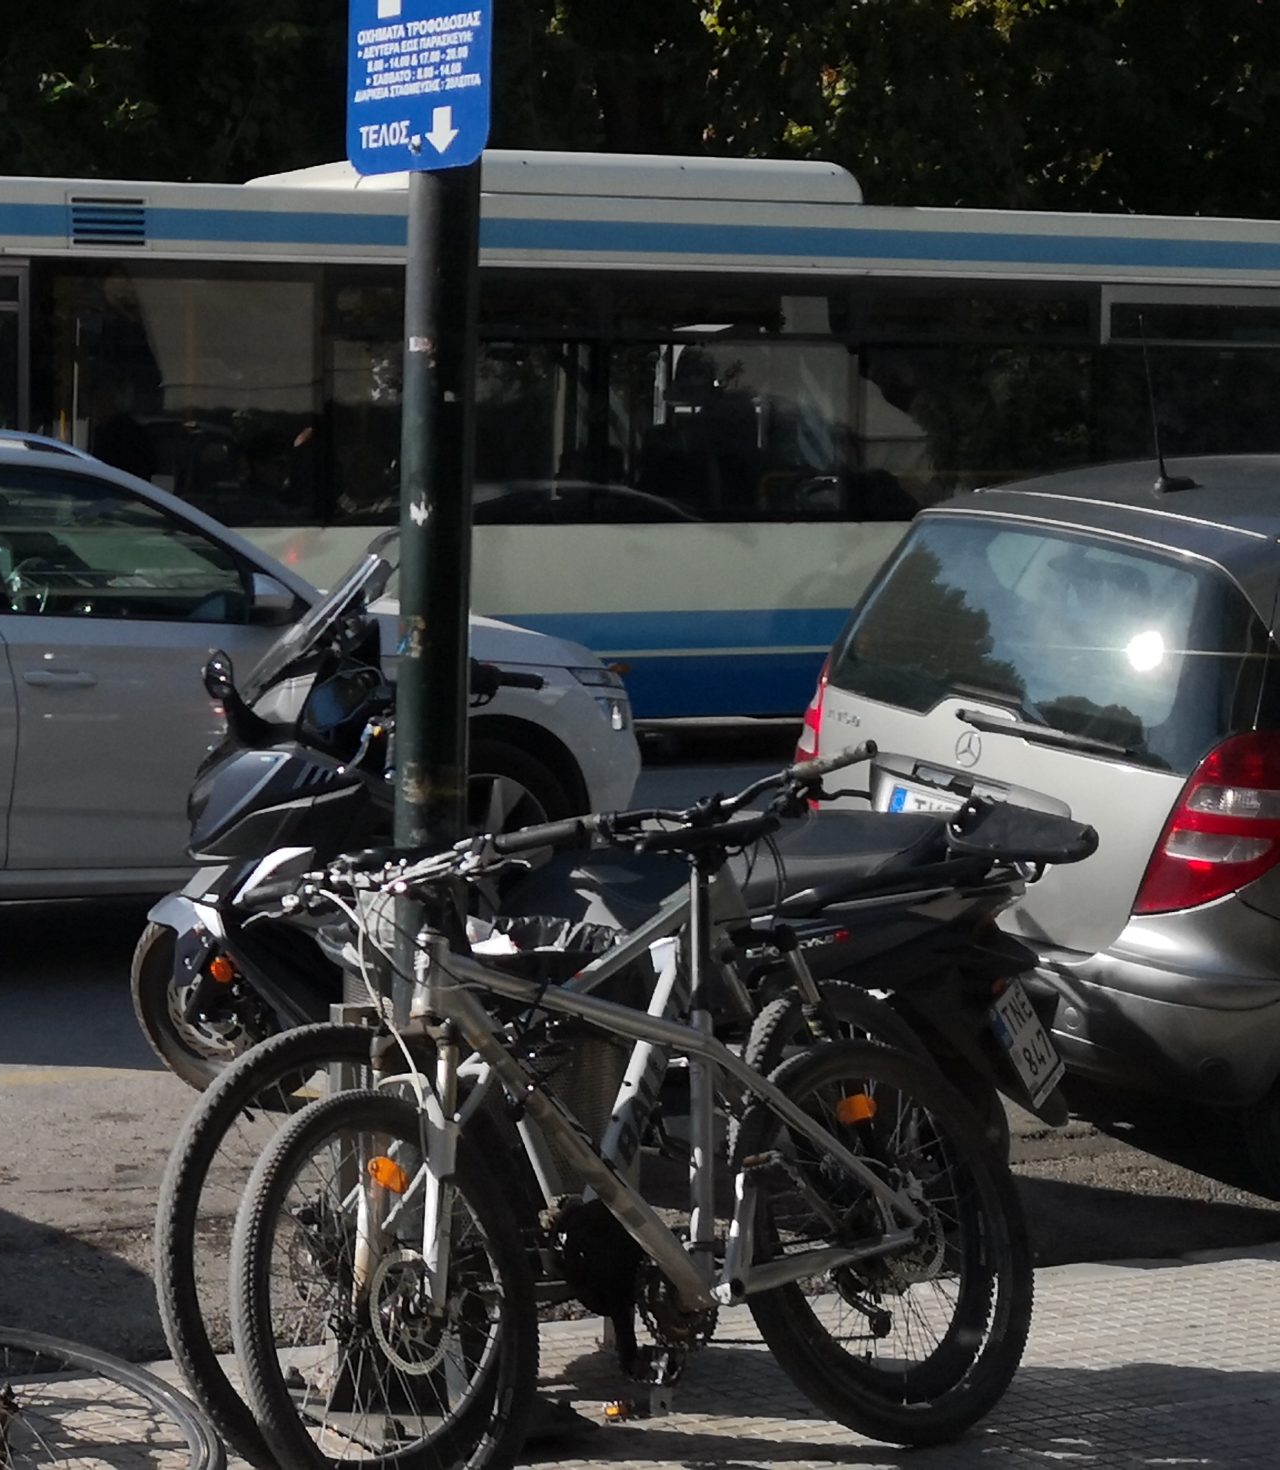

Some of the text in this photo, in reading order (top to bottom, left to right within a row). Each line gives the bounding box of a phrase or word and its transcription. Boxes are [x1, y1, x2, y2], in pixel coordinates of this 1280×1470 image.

[357, 10, 482, 46] ΟΧΗΜΑΤΑ ΤΡΟΦΟΔΟΣΙΑΣ
[363, 42, 400, 59] ΔΕΥΤΕΡΑ
[359, 120, 411, 149] ΤΕΛΟΣ
